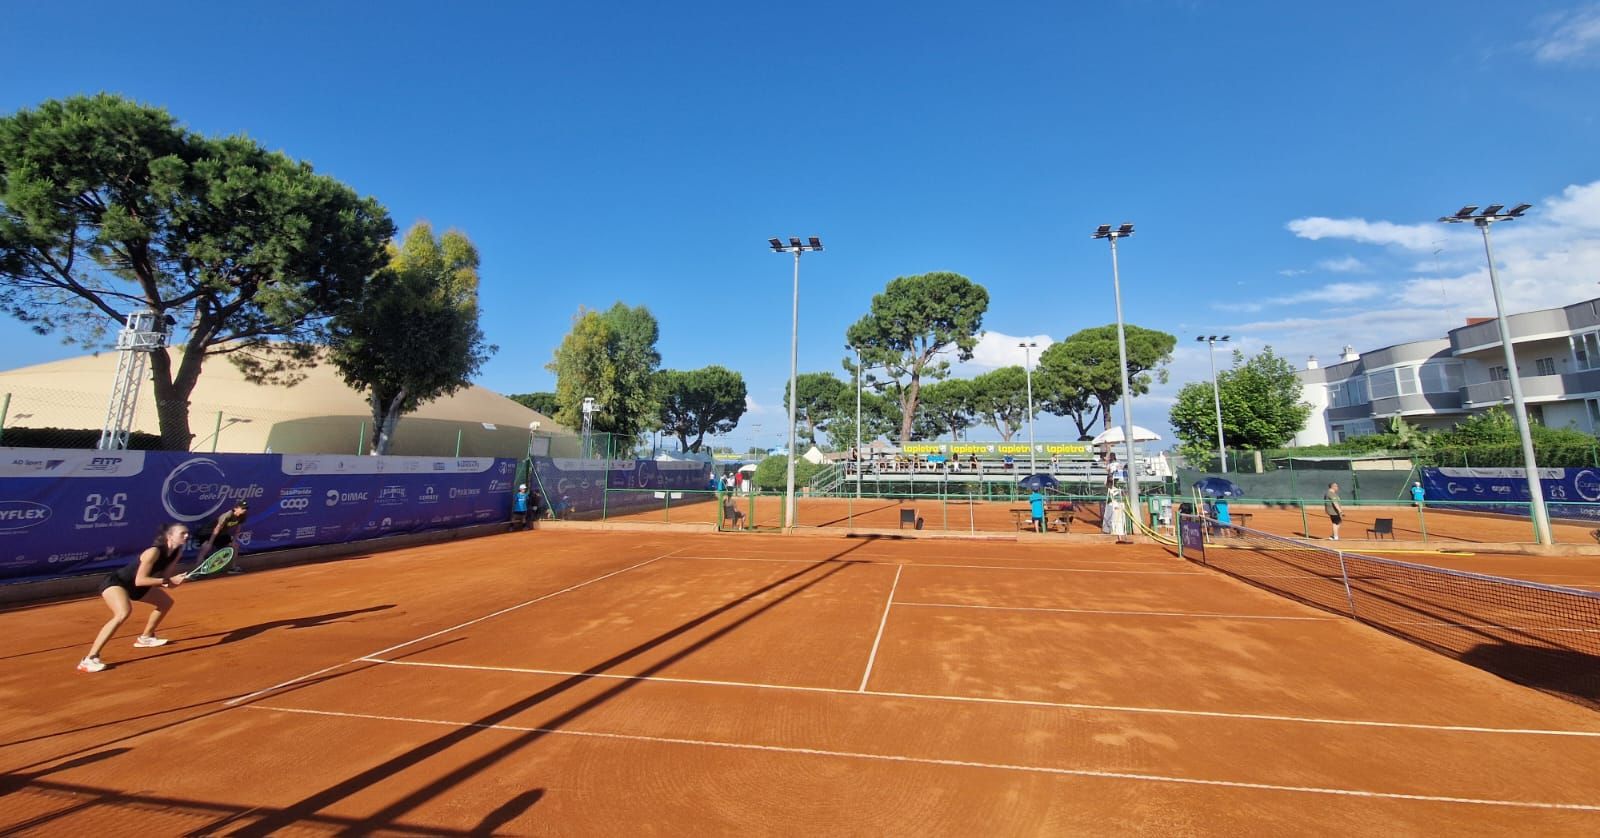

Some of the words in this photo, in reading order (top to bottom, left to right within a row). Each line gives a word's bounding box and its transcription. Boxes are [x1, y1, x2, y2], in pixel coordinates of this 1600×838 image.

[998, 444, 1032, 454] lapietr
[92, 457, 122, 465] FITP
[173, 480, 218, 495] Open
[217, 483, 264, 502] Puglie
[341, 492, 368, 502] DIMAC
[280, 497, 309, 510] coop
